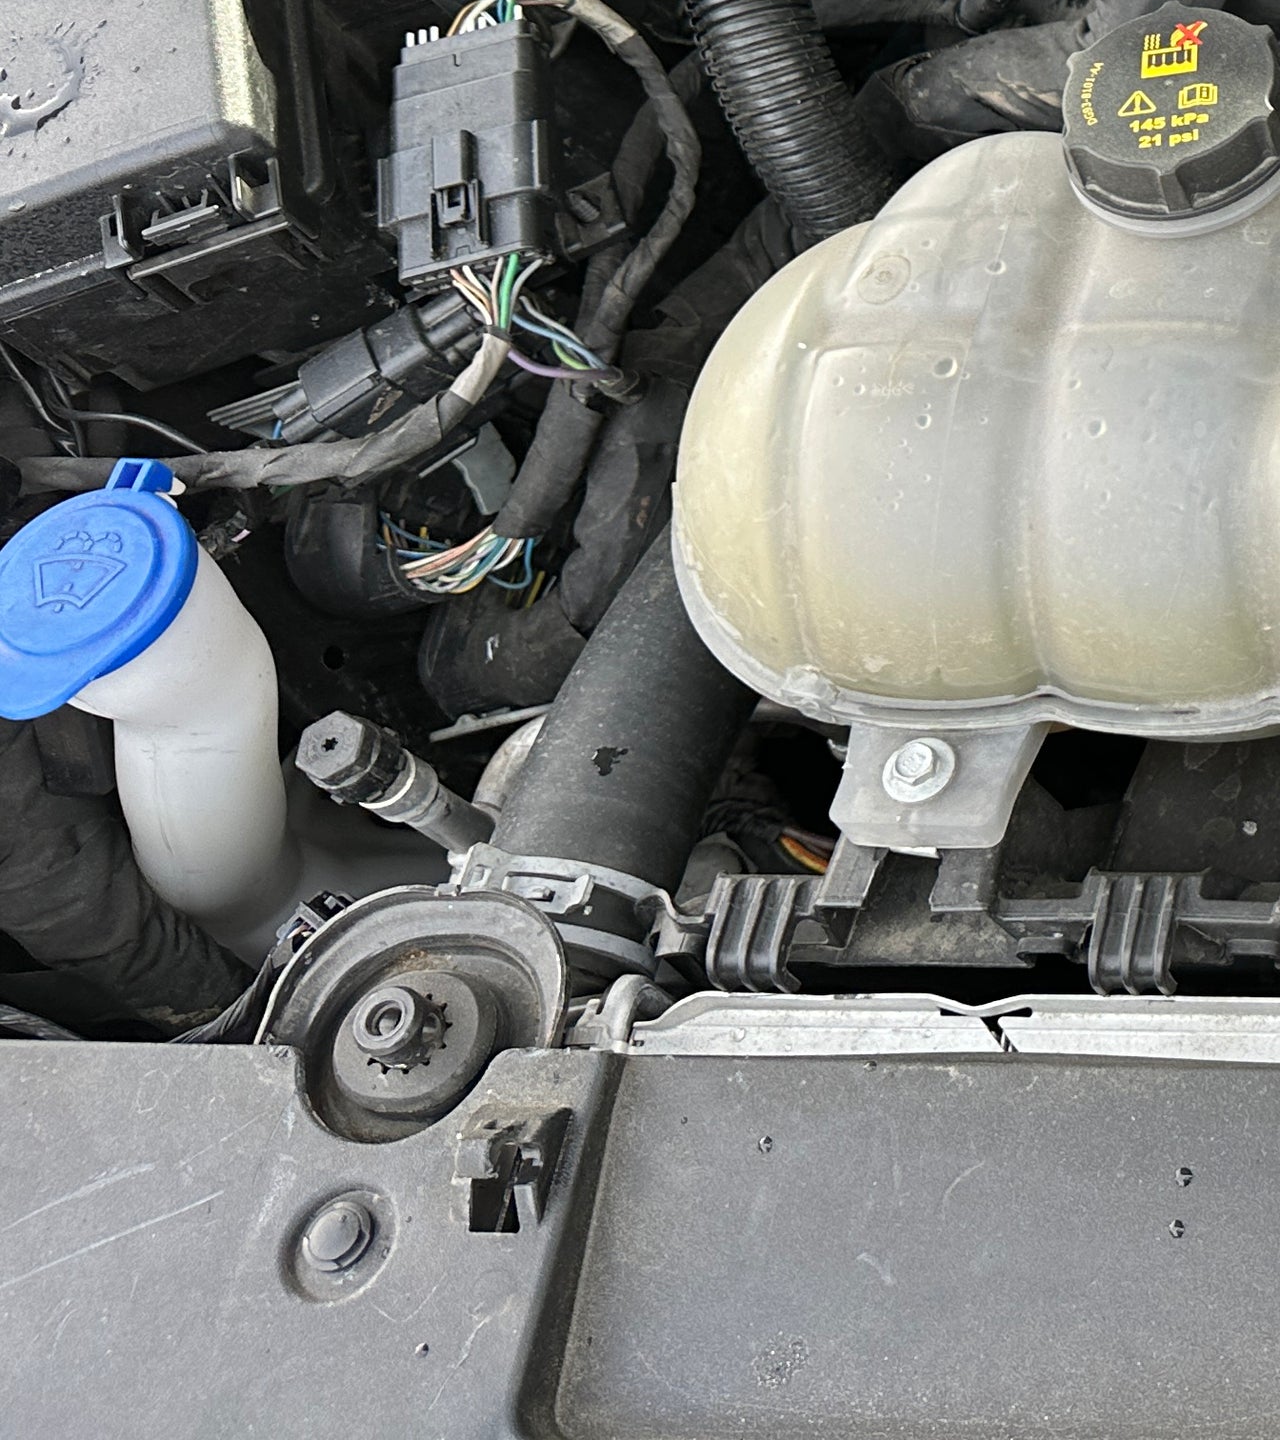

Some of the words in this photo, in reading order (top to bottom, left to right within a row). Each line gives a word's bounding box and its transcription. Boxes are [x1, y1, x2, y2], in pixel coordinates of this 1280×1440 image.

[1129, 116, 1166, 133] 145
[1171, 111, 1210, 130] kPa
[1138, 133, 1162, 149] 21
[1168, 129, 1200, 147] psi
